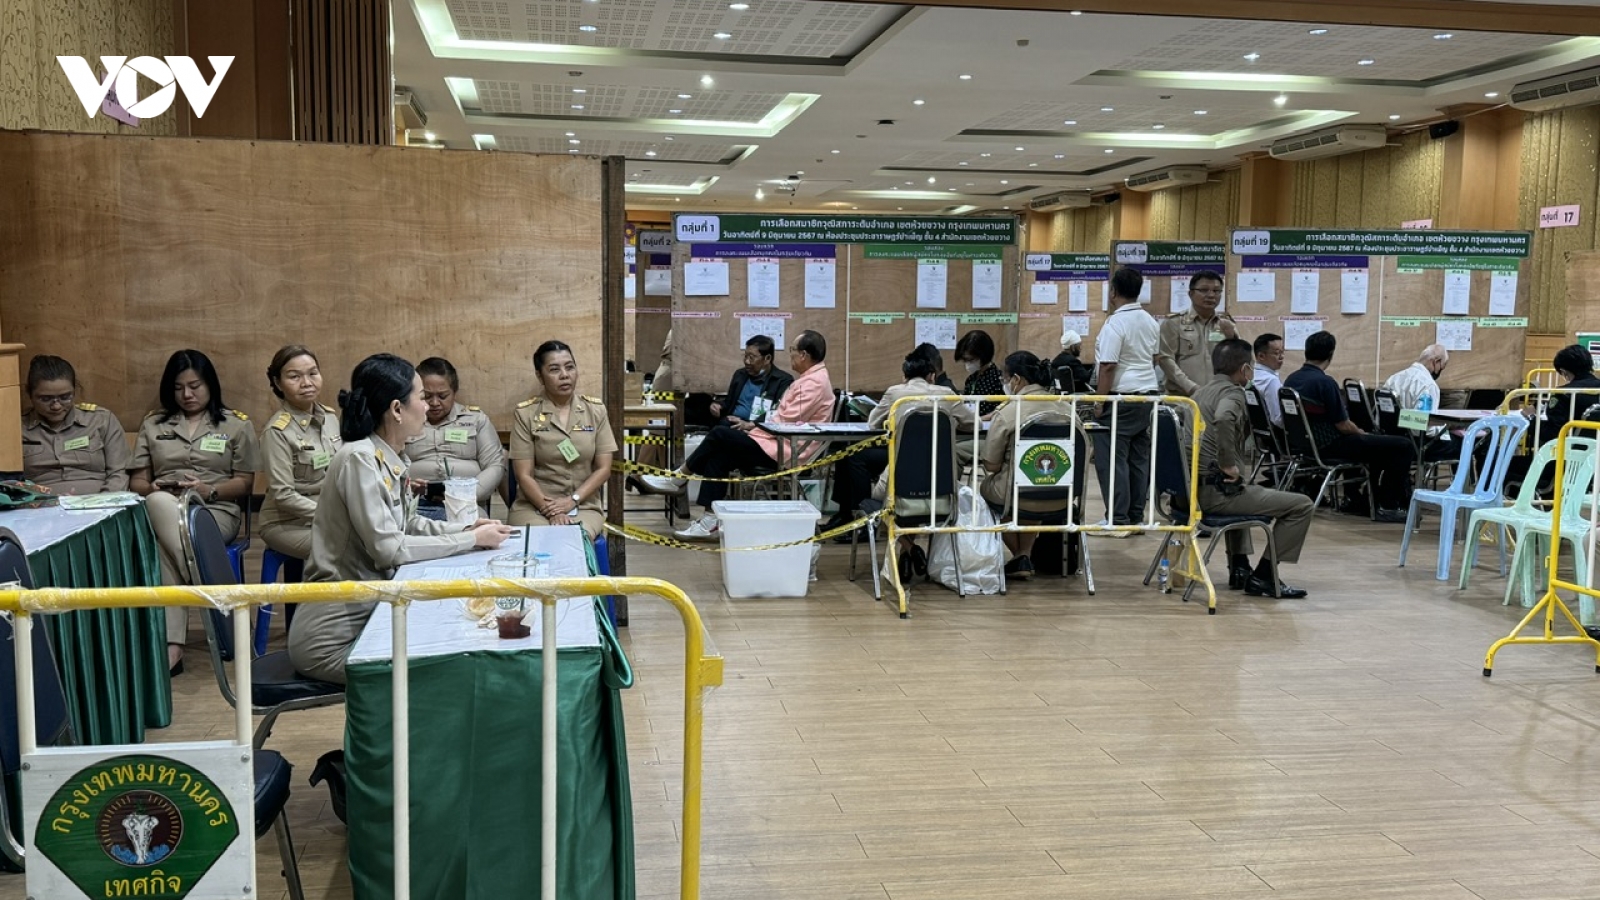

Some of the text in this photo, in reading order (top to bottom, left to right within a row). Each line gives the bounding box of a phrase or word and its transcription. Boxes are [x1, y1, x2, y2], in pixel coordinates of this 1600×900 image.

[1564, 211, 1574, 223] 17
[681, 219, 715, 236] กลุ่มที่ 1
[897, 219, 946, 230] เขตห้วยขวาง
[948, 221, 1011, 231] กรุงเทพมหานคร
[643, 235, 664, 247] กลุ่มที่
[723, 229, 760, 239] วันอาทิตย์ที่
[761, 231, 766, 239] 9
[768, 230, 796, 240] มิถุนายน
[1234, 234, 1268, 248] กลุ่มที่ 19
[1470, 235, 1526, 245] กรุงเทพมหานคร
[1023, 445, 1069, 465] กรุงเทพมหานคร
[52, 763, 228, 833] กรุงเทพมหานคร
[105, 869, 182, 897] เทศกิจ
